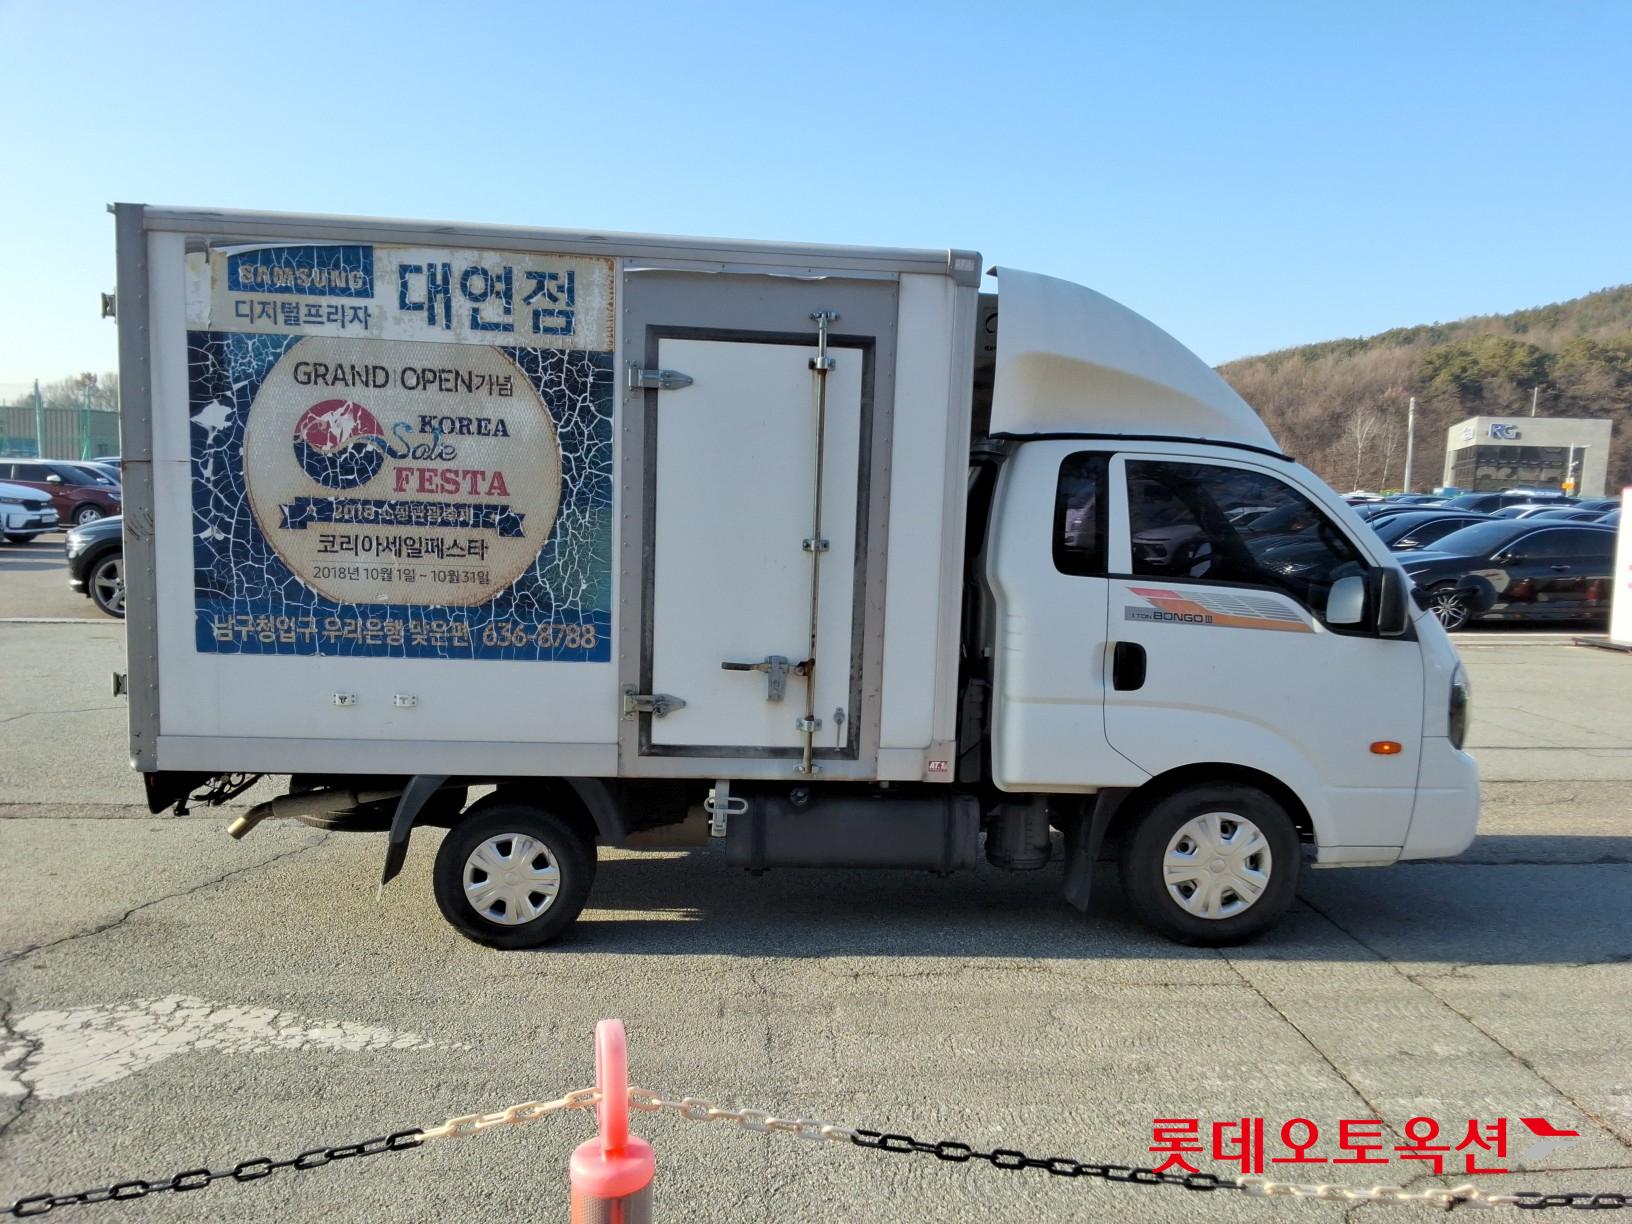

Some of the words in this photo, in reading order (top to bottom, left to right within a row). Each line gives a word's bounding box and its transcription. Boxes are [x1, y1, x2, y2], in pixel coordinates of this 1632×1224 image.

[239, 264, 364, 289] SAMSUNG
[399, 262, 575, 336] 대연점
[235, 300, 372, 330] 디지털프라자
[293, 361, 390, 389] GRAND
[418, 415, 511, 438] KOREA
[390, 420, 458, 461] Sale
[392, 466, 511, 497] FESTA
[335, 505, 375, 520] 2018
[317, 534, 489, 560] 코리아세일페스타
[313, 566, 360, 581] 2018년
[364, 568, 393, 582] 10월
[396, 569, 416, 582] 1일
[431, 570, 460, 584] 10월
[463, 571, 490, 585] 31일
[1153, 611, 1204, 623] BONGO
[213, 614, 319, 643] 남구청입구
[322, 617, 404, 646] 우리은행
[482, 622, 596, 649] 636-8788
